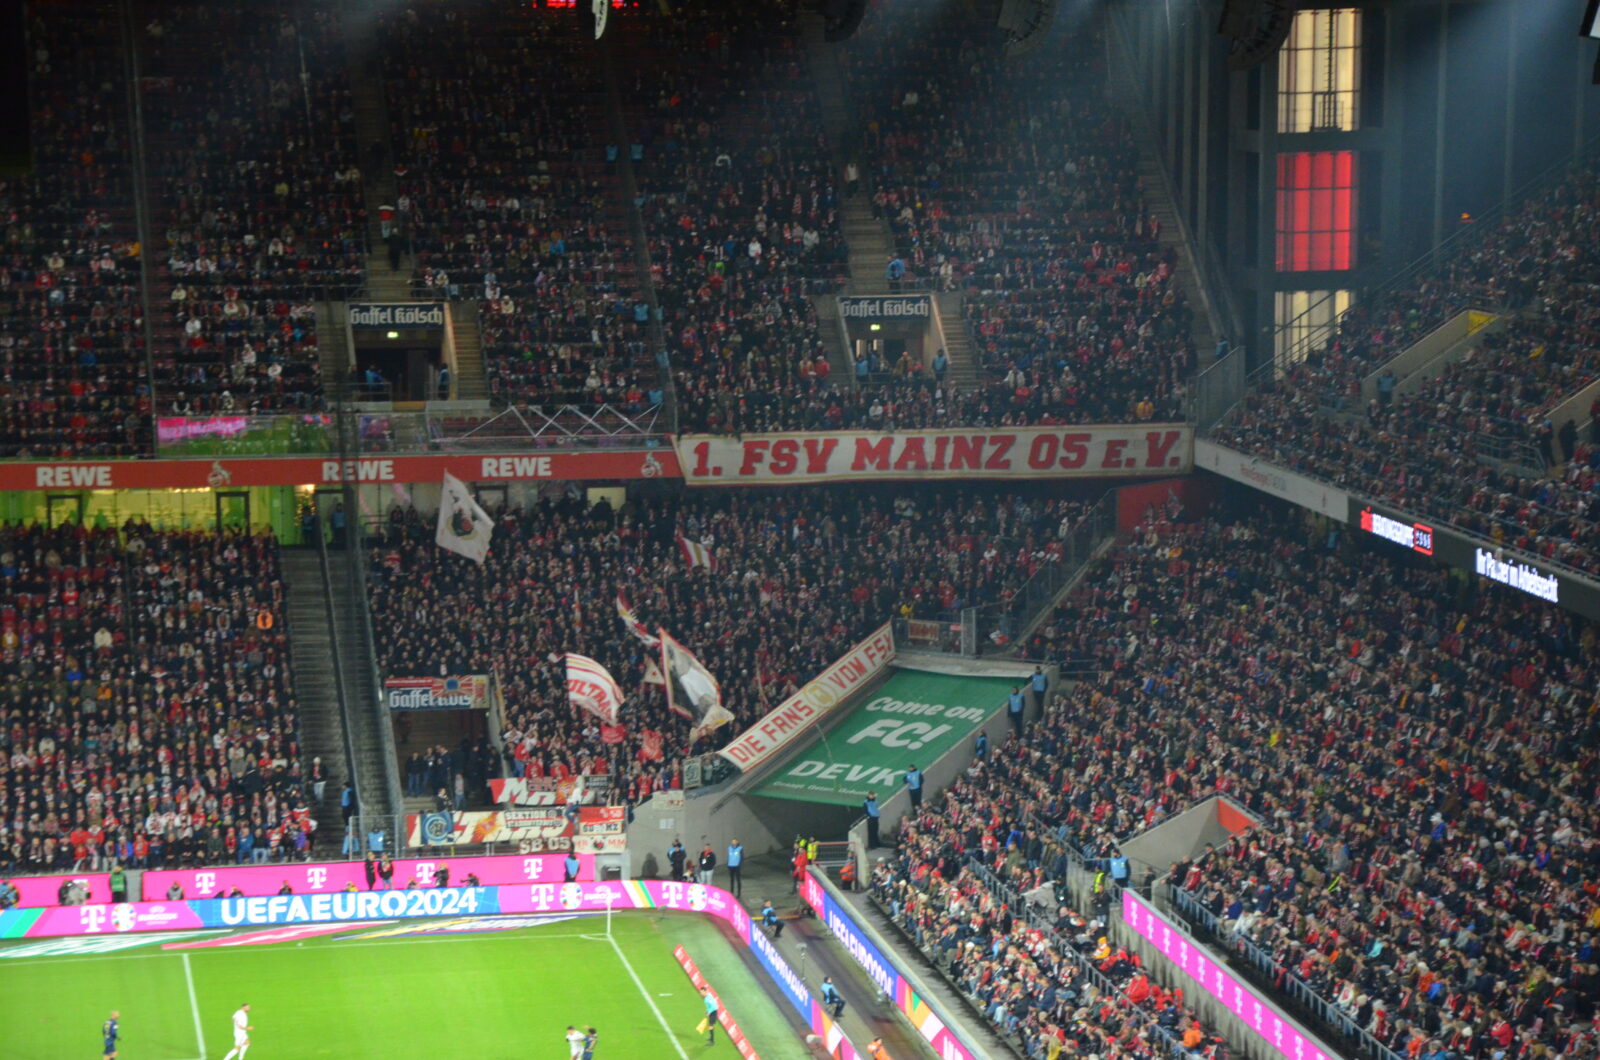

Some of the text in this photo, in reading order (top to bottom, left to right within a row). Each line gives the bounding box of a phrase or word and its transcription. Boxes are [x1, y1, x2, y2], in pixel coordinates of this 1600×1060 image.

[350, 306, 442, 325] Gaffel Kölsch
[841, 299, 929, 317] Gaffel Kölsch
[692, 441, 722, 477] 1.
[739, 438, 838, 477] FSV
[850, 434, 1016, 472] MAINZ
[1028, 433, 1091, 470] 05
[36, 466, 112, 487] REWE
[322, 460, 395, 481] REWE
[482, 457, 552, 478] REWE
[865, 696, 986, 723] Come on,
[728, 735, 767, 763] DIE
[760, 700, 815, 743] FANS
[847, 719, 954, 750] FC!
[787, 760, 908, 787] DEVK
